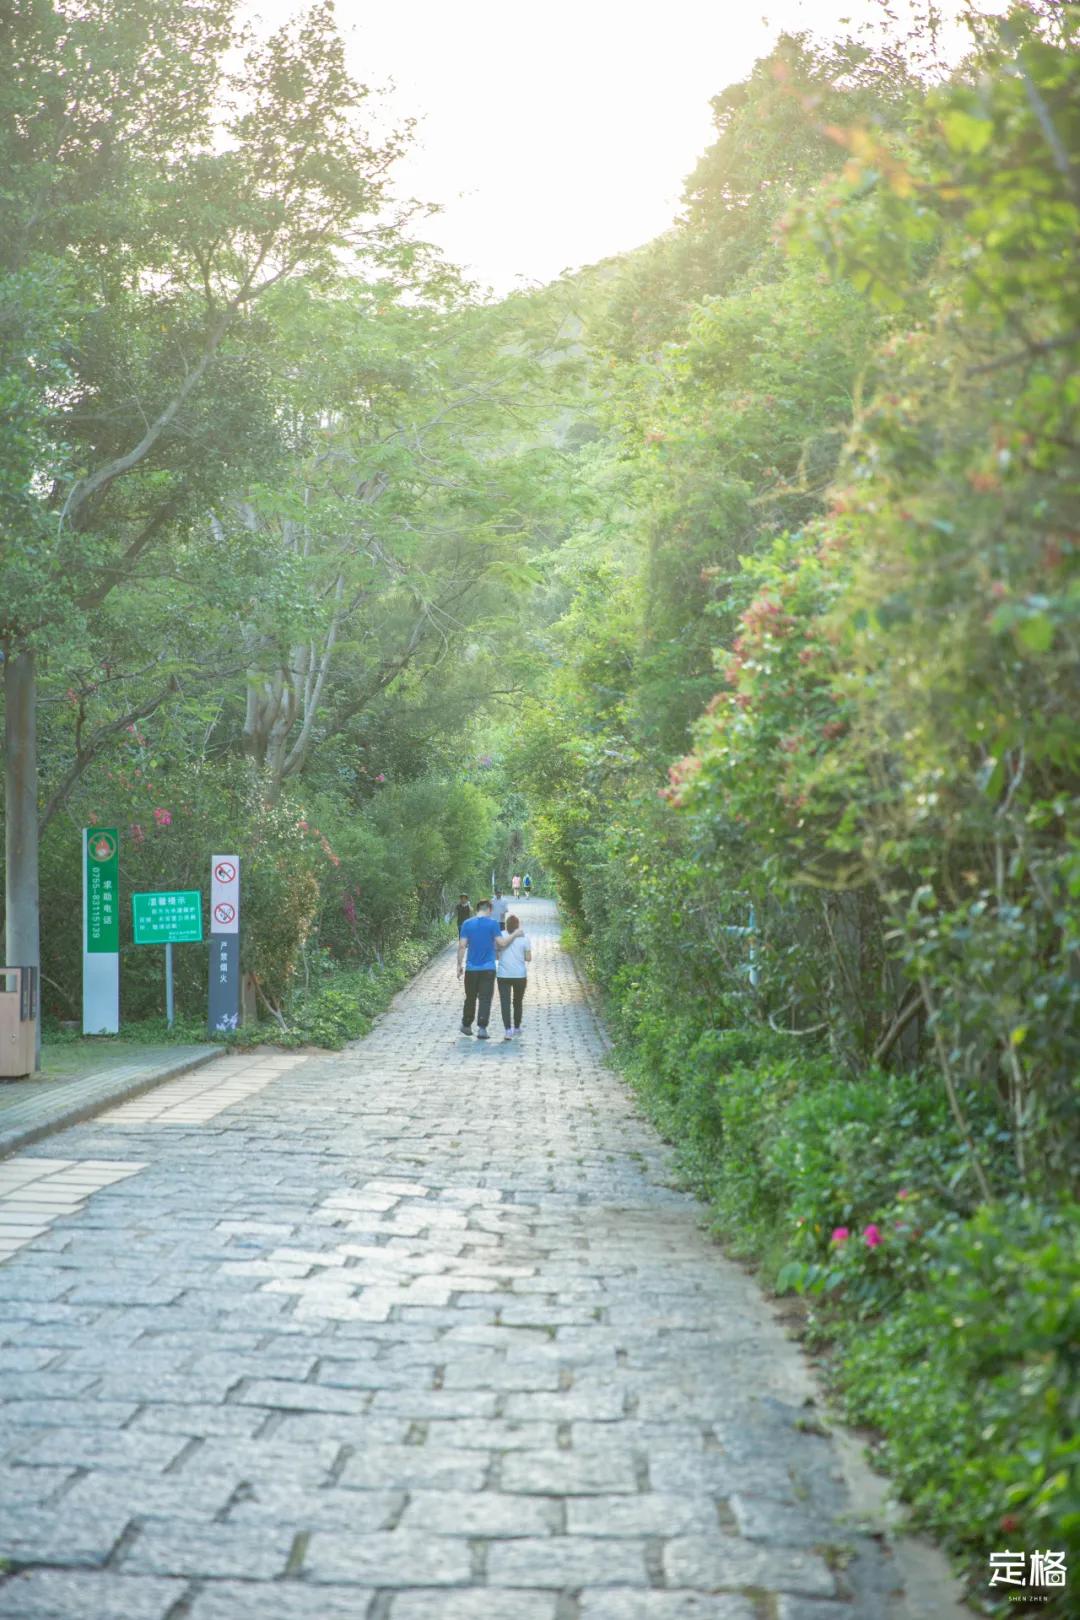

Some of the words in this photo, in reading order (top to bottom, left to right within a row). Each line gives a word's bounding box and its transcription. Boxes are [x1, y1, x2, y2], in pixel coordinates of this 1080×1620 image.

[103, 880, 112, 925] 求助电话
[220, 941, 228, 983] 严禁烟火
